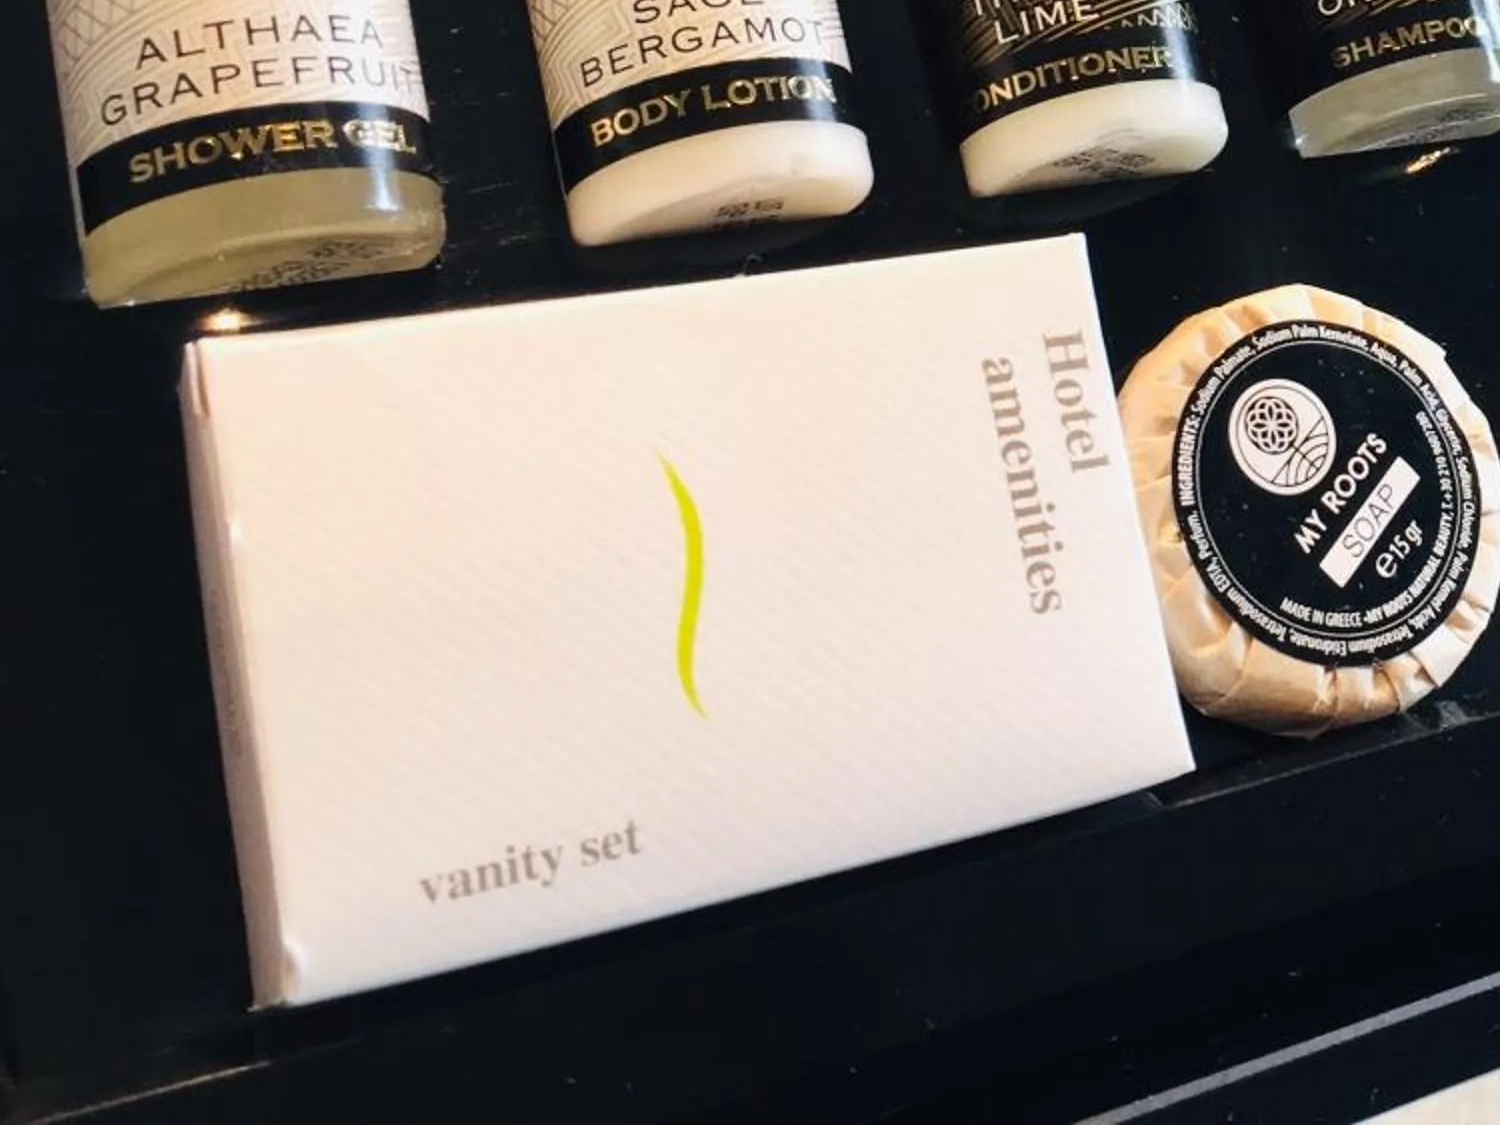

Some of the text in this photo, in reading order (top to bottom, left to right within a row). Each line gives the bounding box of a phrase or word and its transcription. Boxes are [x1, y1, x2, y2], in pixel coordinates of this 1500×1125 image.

[135, 14, 383, 70] ALTHAEA
[580, 17, 823, 87] BERGAMOT
[1331, 15, 1484, 68] SHAMPOO
[101, 56, 420, 126] GRAPEFRUIT
[590, 75, 837, 147] BODY LOTION
[972, 45, 1175, 111] ONDITIONER
[129, 119, 417, 183] SHOWER GEL
[1042, 328, 1110, 474] Hotel
[982, 356, 1064, 615] amenities
[1294, 433, 1387, 554] MY ROOTS
[1342, 482, 1394, 558] SOAP
[419, 820, 643, 904] vanity set
